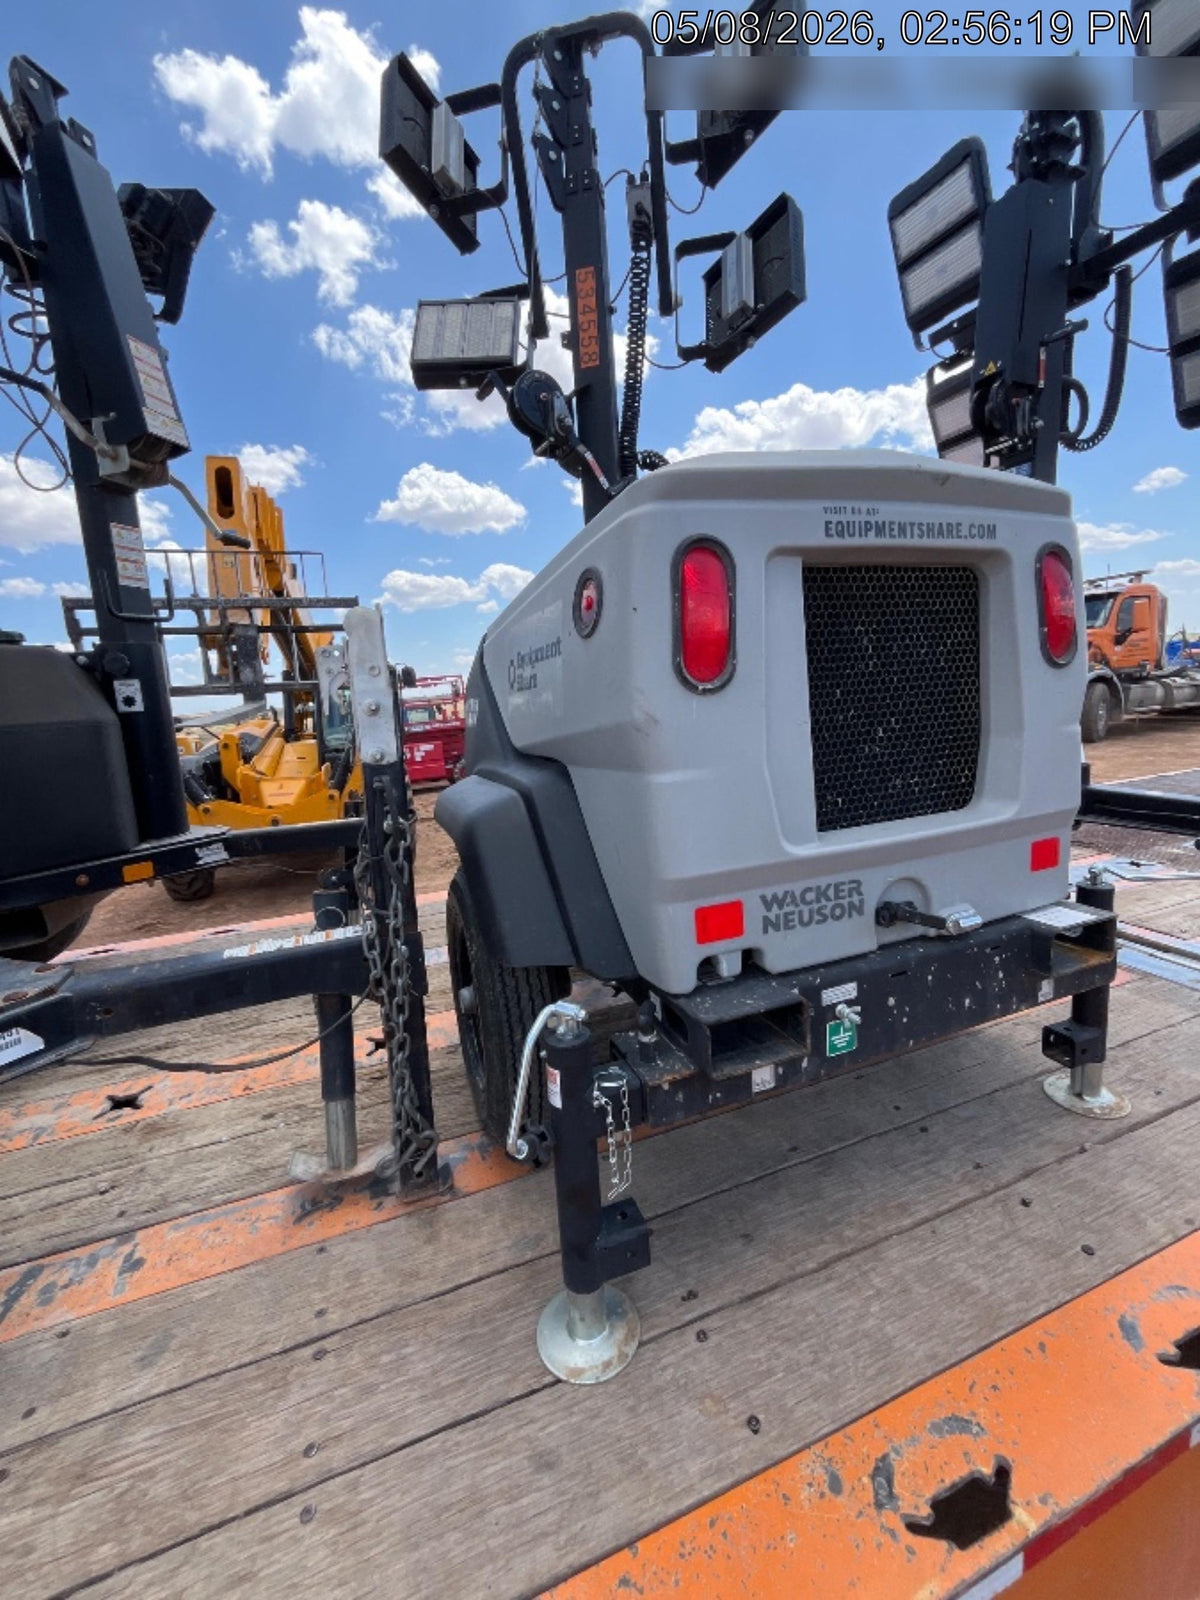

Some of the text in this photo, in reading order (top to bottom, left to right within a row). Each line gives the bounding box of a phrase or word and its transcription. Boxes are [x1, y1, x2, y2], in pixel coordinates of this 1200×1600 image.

[576, 270, 599, 364] 534558
[822, 505, 847, 515] VISIT
[824, 519, 997, 540] EQUIPMENTSHARE.COM
[759, 879, 864, 912] WACKER
[762, 897, 865, 934] NEUSON
